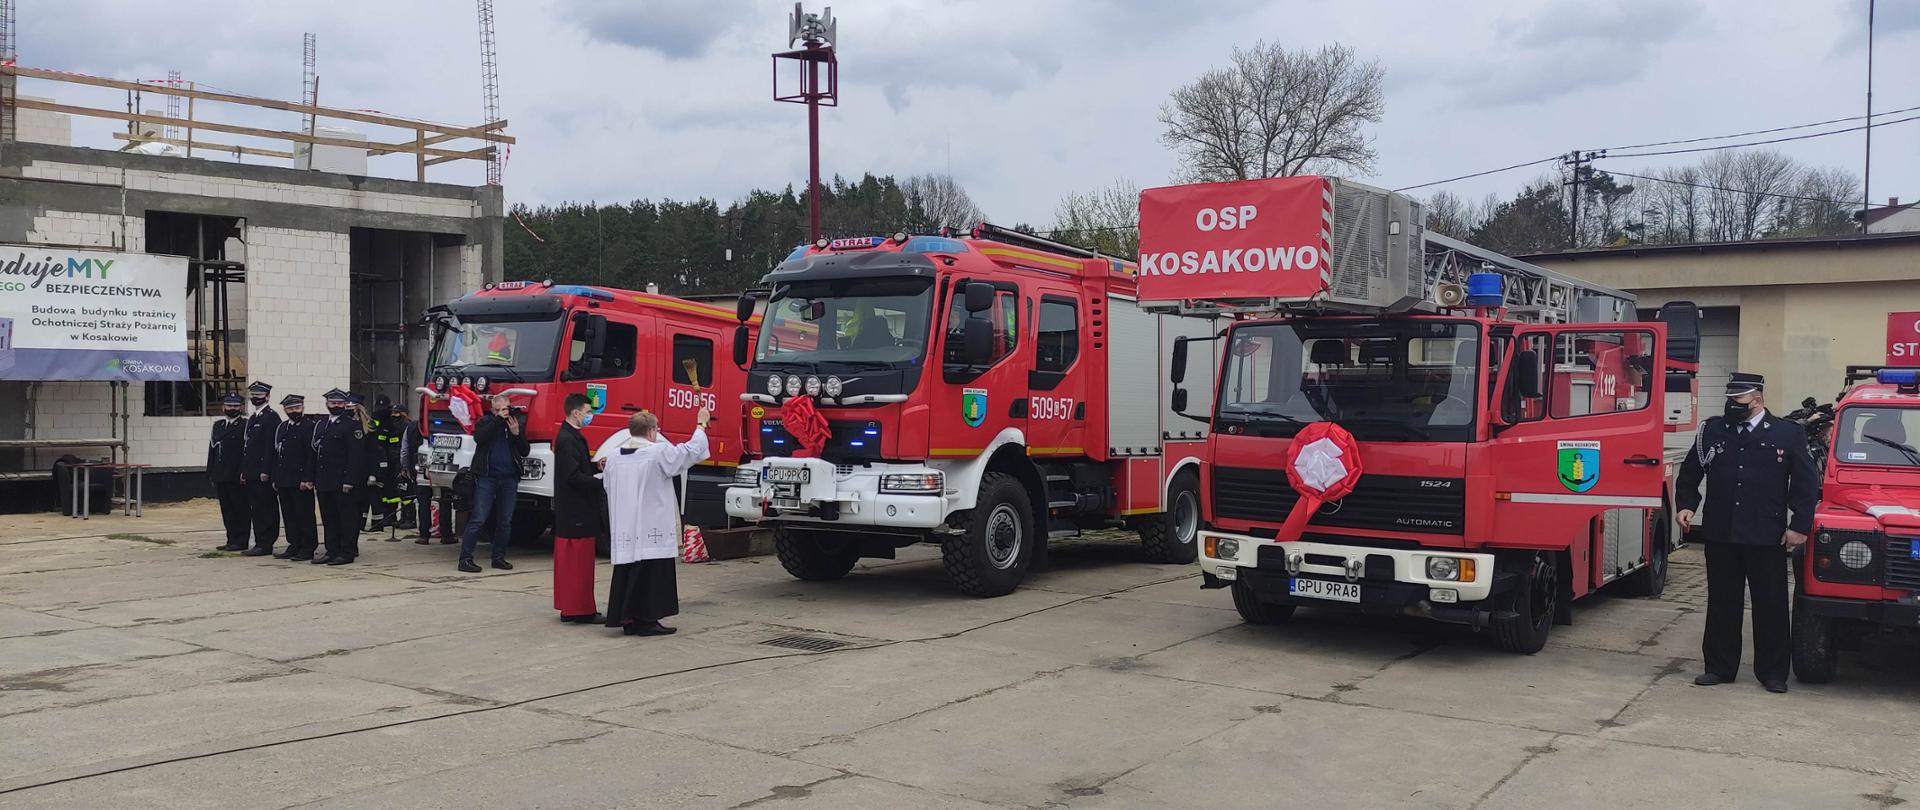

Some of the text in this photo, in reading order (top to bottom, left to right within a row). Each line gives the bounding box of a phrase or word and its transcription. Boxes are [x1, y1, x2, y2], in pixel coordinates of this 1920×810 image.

[1196, 205, 1258, 232] OSP
[1140, 245, 1319, 277] KOSAKOWO
[46, 284, 162, 298] BEZPIECZEŃSTWA
[31, 305, 176, 320] Budowa budynku strażnicy
[31, 317, 177, 332] Ochotniczej Straży Pożarnej
[82, 333, 138, 342] Kosakowie
[1892, 342, 1920, 357] ST
[122, 364, 181, 373] KOSAKOWO
[1604, 374, 1616, 396] 112
[668, 388, 693, 409] 509
[1031, 396, 1053, 420] 509
[1420, 480, 1452, 488] 1524
[1396, 518, 1453, 527] AUTOMATIC
[1297, 579, 1358, 598] GPU 9RA8
